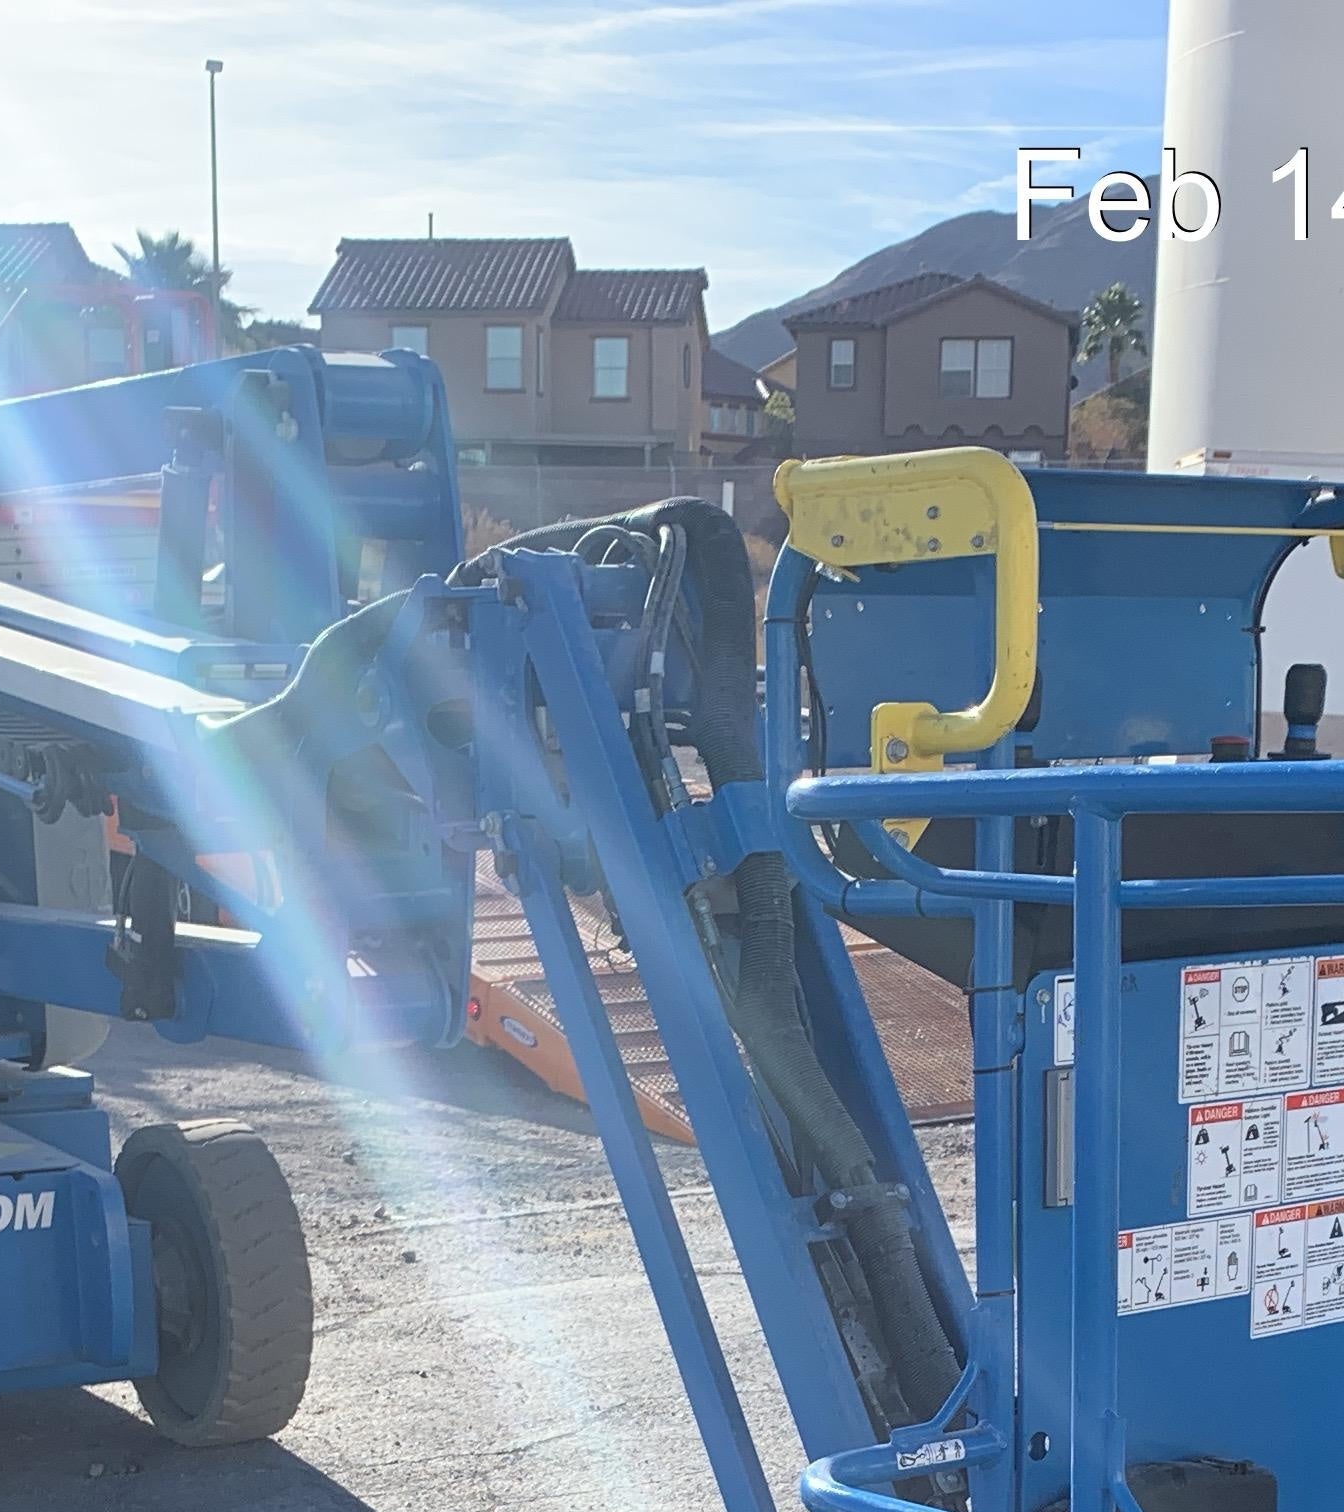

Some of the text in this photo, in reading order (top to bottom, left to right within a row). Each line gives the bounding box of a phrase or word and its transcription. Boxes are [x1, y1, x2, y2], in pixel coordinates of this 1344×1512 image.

[1307, 1090, 1341, 1107] DANGER
[1204, 1105, 1239, 1120] DANGER
[1270, 1207, 1302, 1224] DANGER
